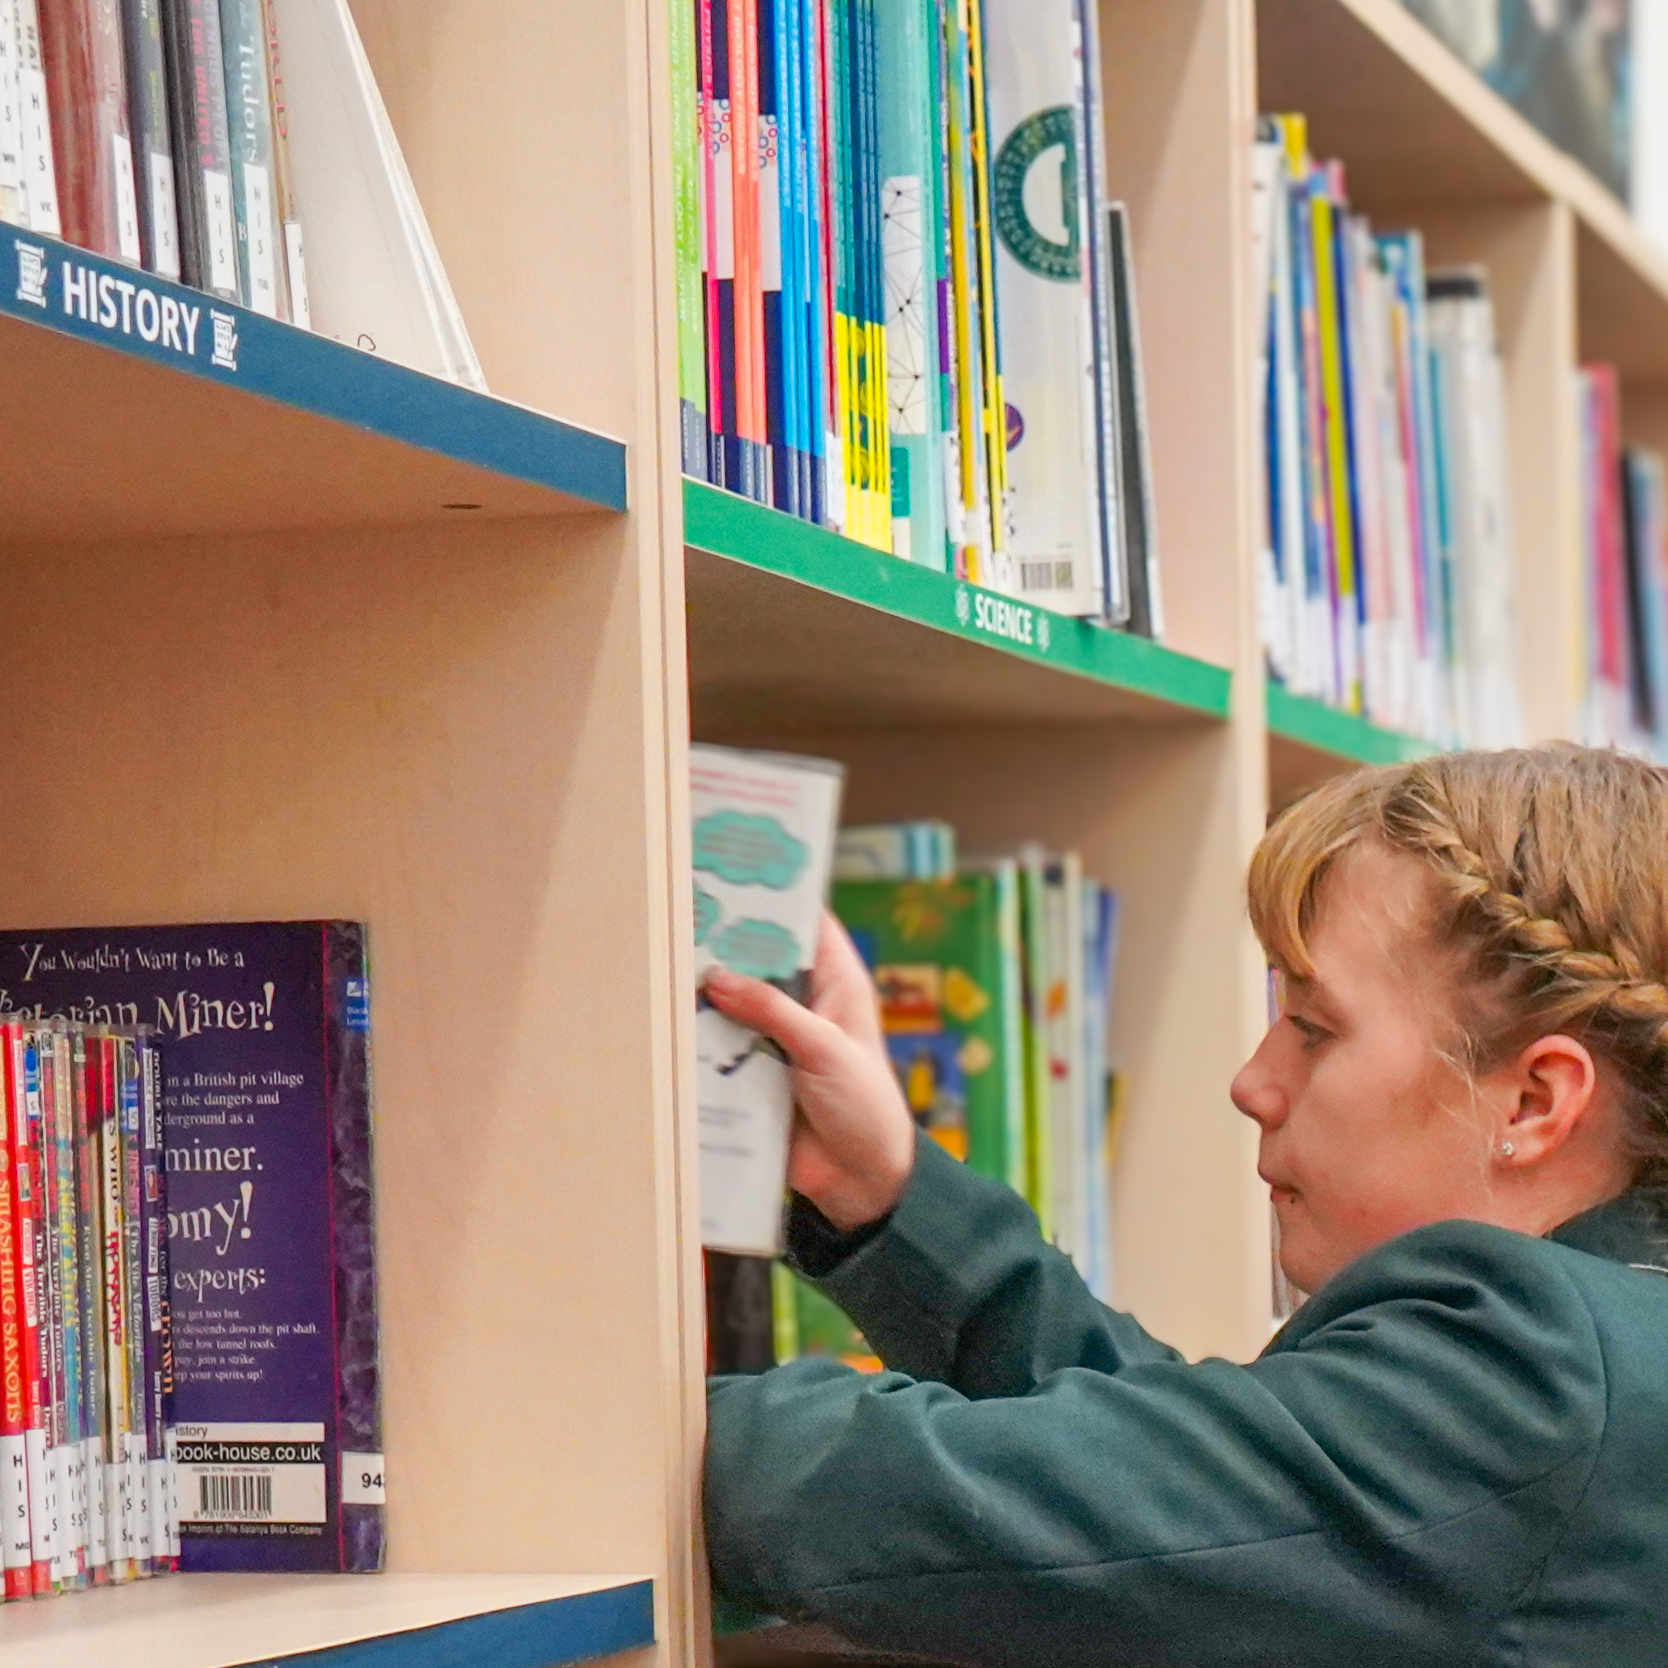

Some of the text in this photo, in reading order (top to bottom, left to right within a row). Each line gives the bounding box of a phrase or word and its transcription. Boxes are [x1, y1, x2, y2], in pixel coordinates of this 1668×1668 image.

[0, 39, 12, 121] HIS
[237, 38, 258, 162] Tudors
[32, 95, 45, 172] HIS
[214, 195, 226, 265] HIS
[253, 185, 264, 256] HIS
[62, 262, 199, 355] HISTORY
[974, 592, 1033, 646] SCIENCE
[20, 943, 229, 982] You Wouldn't Want to Be
[155, 981, 275, 1040] Miner!
[182, 1091, 280, 1109] the dangers and
[194, 1071, 304, 1090] British pit village
[229, 1113, 244, 1125] as
[165, 1137, 264, 1172] miner.
[22, 1268, 37, 1320] VIKINGS
[34, 1233, 51, 1378] The Terrible Tudors
[128, 1229, 144, 1364] The Vile Victorians
[147, 1276, 160, 1325] TUDORS
[173, 1267, 266, 1303] experts:
[50, 1259, 64, 1372] Terrible Tudors
[82, 1224, 97, 1418] Even Tudors
[216, 1339, 247, 1350] tunnel
[229, 1322, 290, 1336] down the pit
[1, 1320, 24, 1423] SAXONS
[159, 1300, 173, 1393] crown
[215, 1370, 244, 1383] spirits
[229, 1354, 255, 1366] strike
[13, 1453, 27, 1519] HIS
[139, 1451, 148, 1513] HIS
